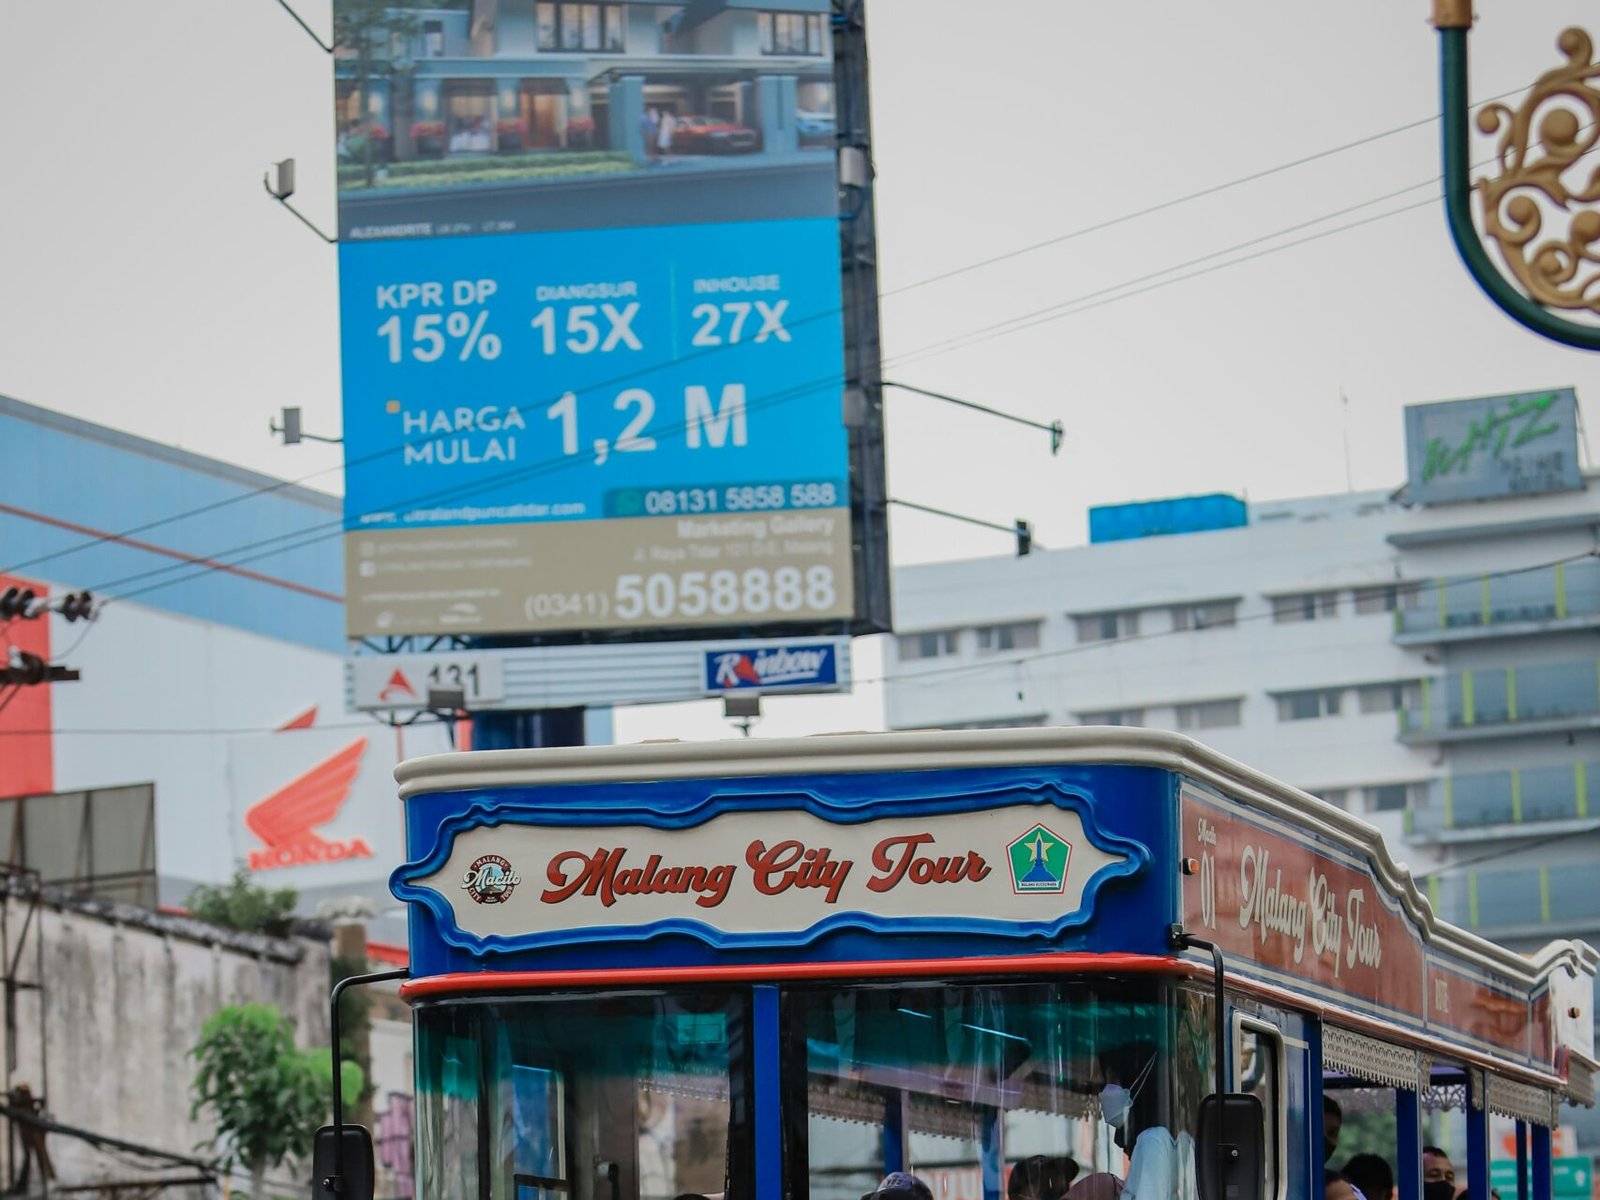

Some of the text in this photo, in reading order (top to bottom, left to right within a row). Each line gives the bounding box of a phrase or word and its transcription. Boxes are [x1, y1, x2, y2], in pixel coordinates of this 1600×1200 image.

[377, 279, 498, 309] KPR DP
[536, 281, 638, 301] DIANGSUR
[693, 274, 781, 294] INHOUSE
[377, 310, 502, 363] 15%
[531, 302, 643, 355] 15X
[690, 299, 792, 346] 27X
[403, 406, 526, 434] HARGA
[547, 383, 748, 466] 1,2 M
[403, 437, 516, 465] MULAI
[645, 482, 837, 514] 08131 5858 588
[677, 515, 835, 540] Marketing Gallery
[525, 564, 837, 621] (0341) 5058888
[248, 836, 376, 872] HONDA
[477, 856, 506, 867] MALANG
[540, 832, 992, 908] Malang City Tour
[461, 868, 521, 890] Macito
[1200, 849, 1217, 931] 01
[1239, 844, 1382, 979] Malang City Tour
